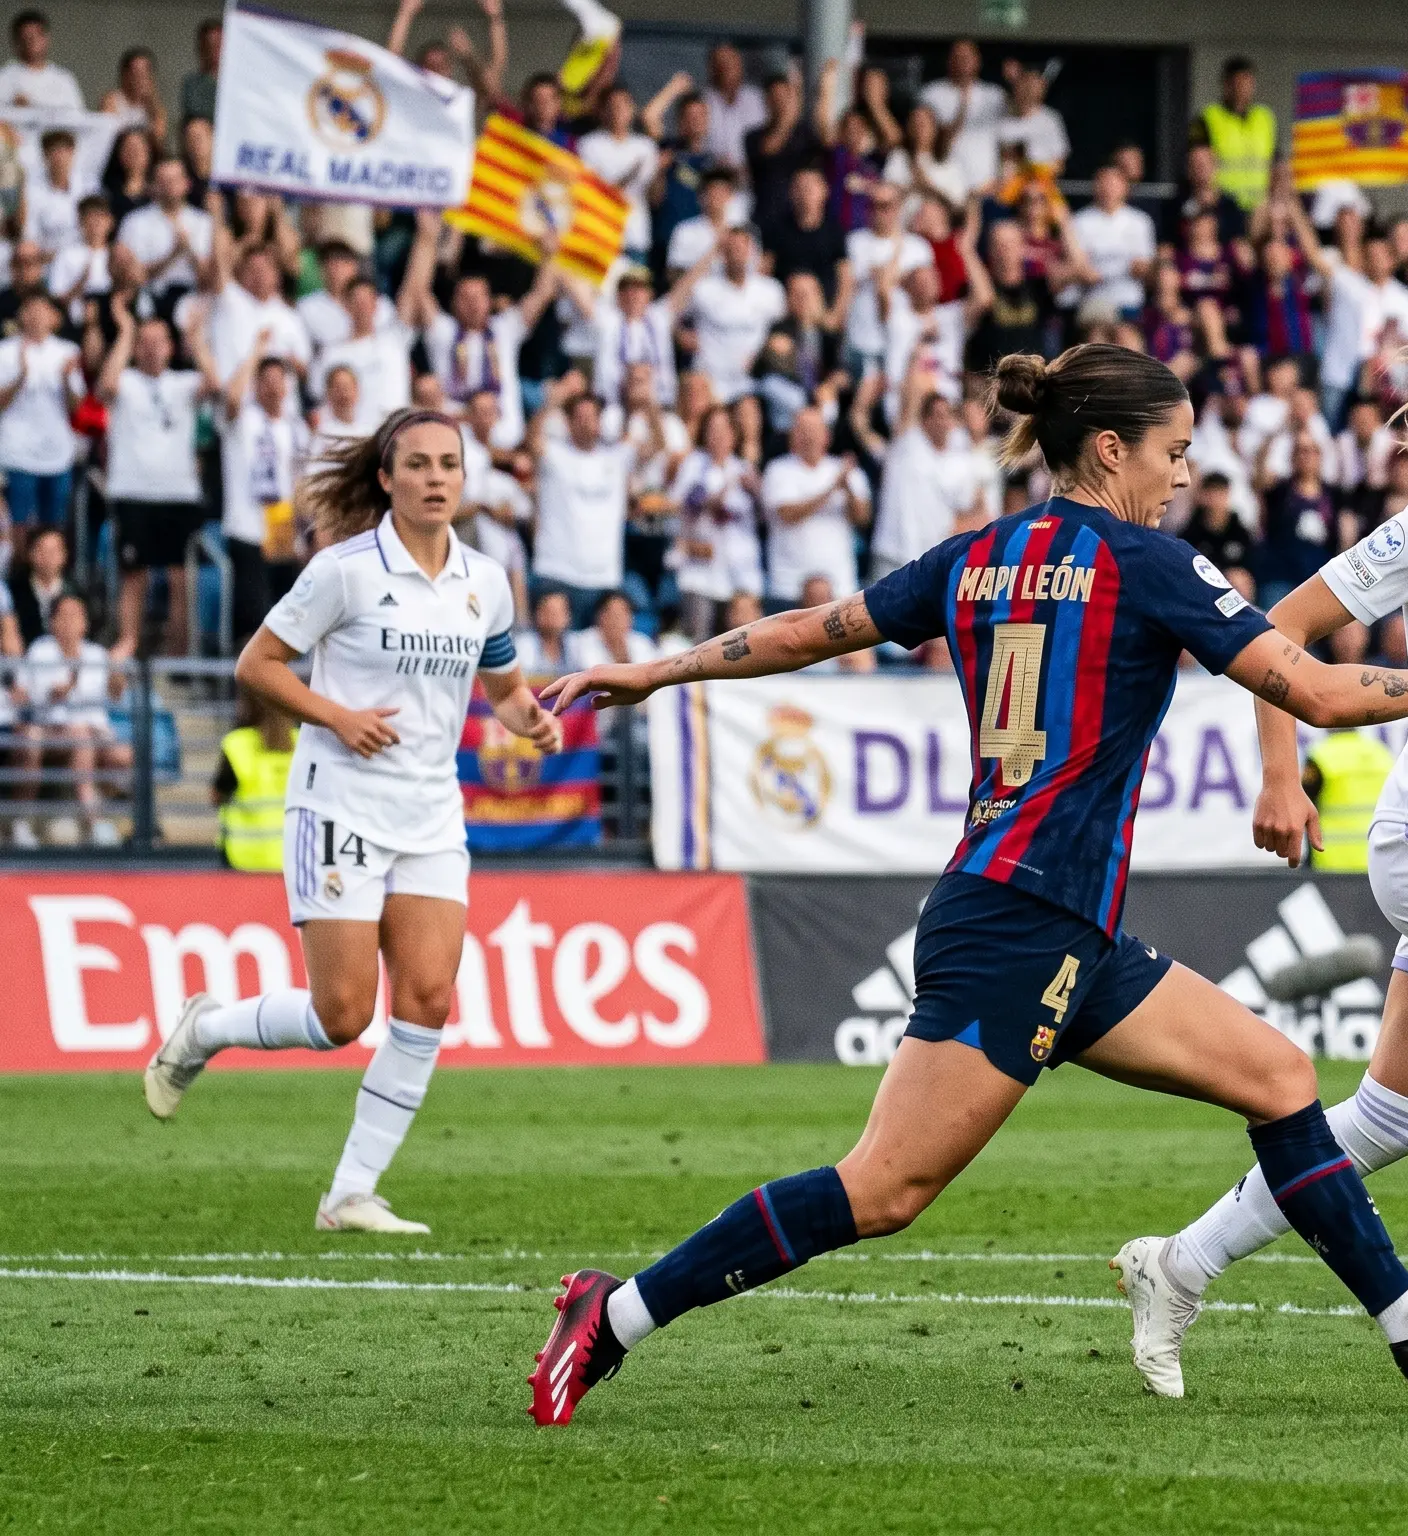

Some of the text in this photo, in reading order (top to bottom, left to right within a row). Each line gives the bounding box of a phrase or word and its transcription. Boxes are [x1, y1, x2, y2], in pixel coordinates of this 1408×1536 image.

[235, 142, 310, 178] REAL
[957, 555, 1096, 602] MAPI LEÓN
[381, 628, 480, 656] Emirates
[396, 656, 469, 678] FLY BETTER
[980, 624, 1046, 787] 4
[321, 821, 367, 867] 14
[28, 895, 711, 1052] Emates
[1041, 954, 1080, 1024] 4
